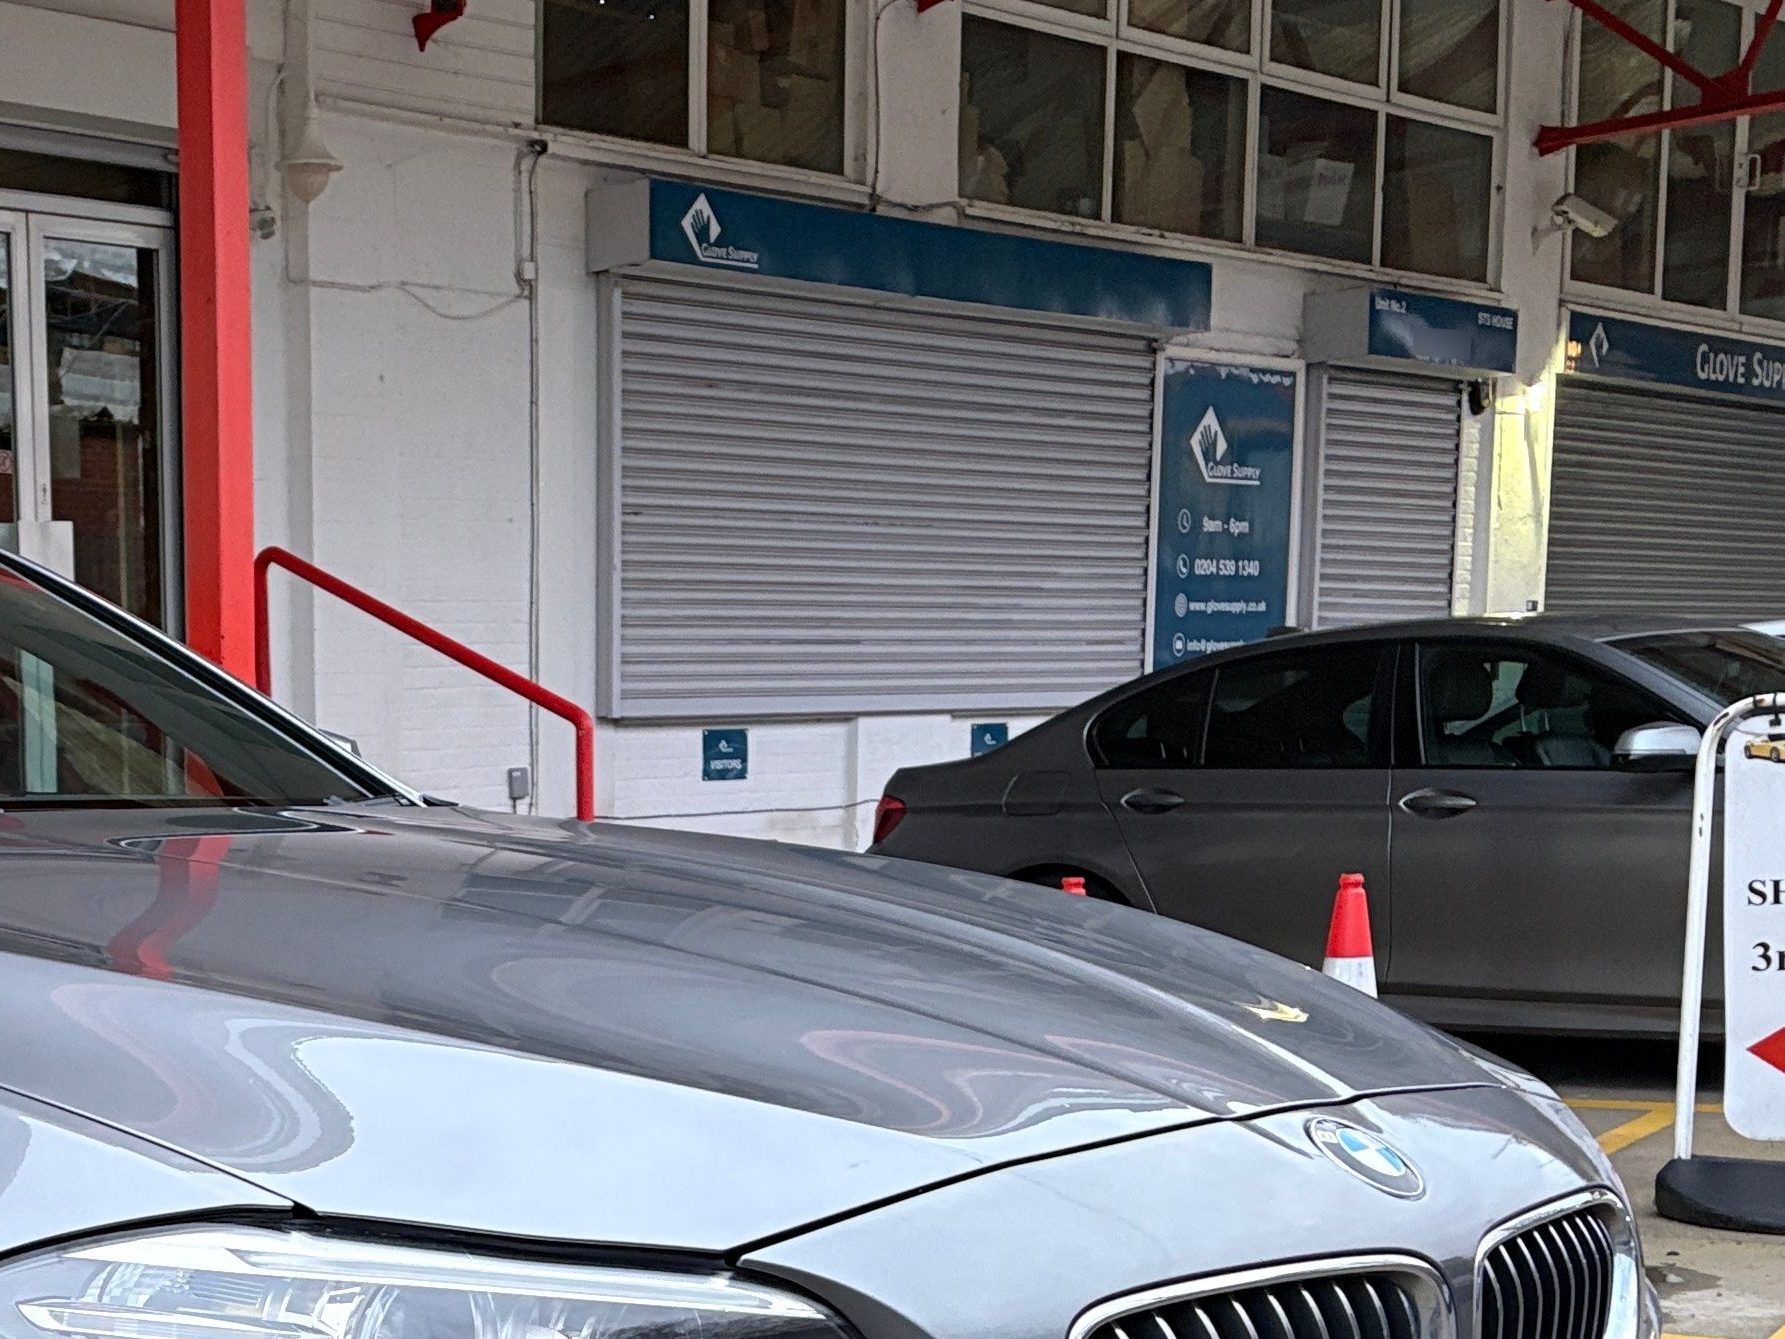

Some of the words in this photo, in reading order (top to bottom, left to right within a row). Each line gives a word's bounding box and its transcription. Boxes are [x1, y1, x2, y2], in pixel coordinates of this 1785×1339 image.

[1202, 516, 1223, 532] 9am
[1229, 518, 1249, 537] 6pm
[1194, 559, 1216, 575] 0204
[1219, 559, 1235, 575] 539
[1238, 560, 1260, 576] 1340
[710, 758, 743, 770] VISITORS
